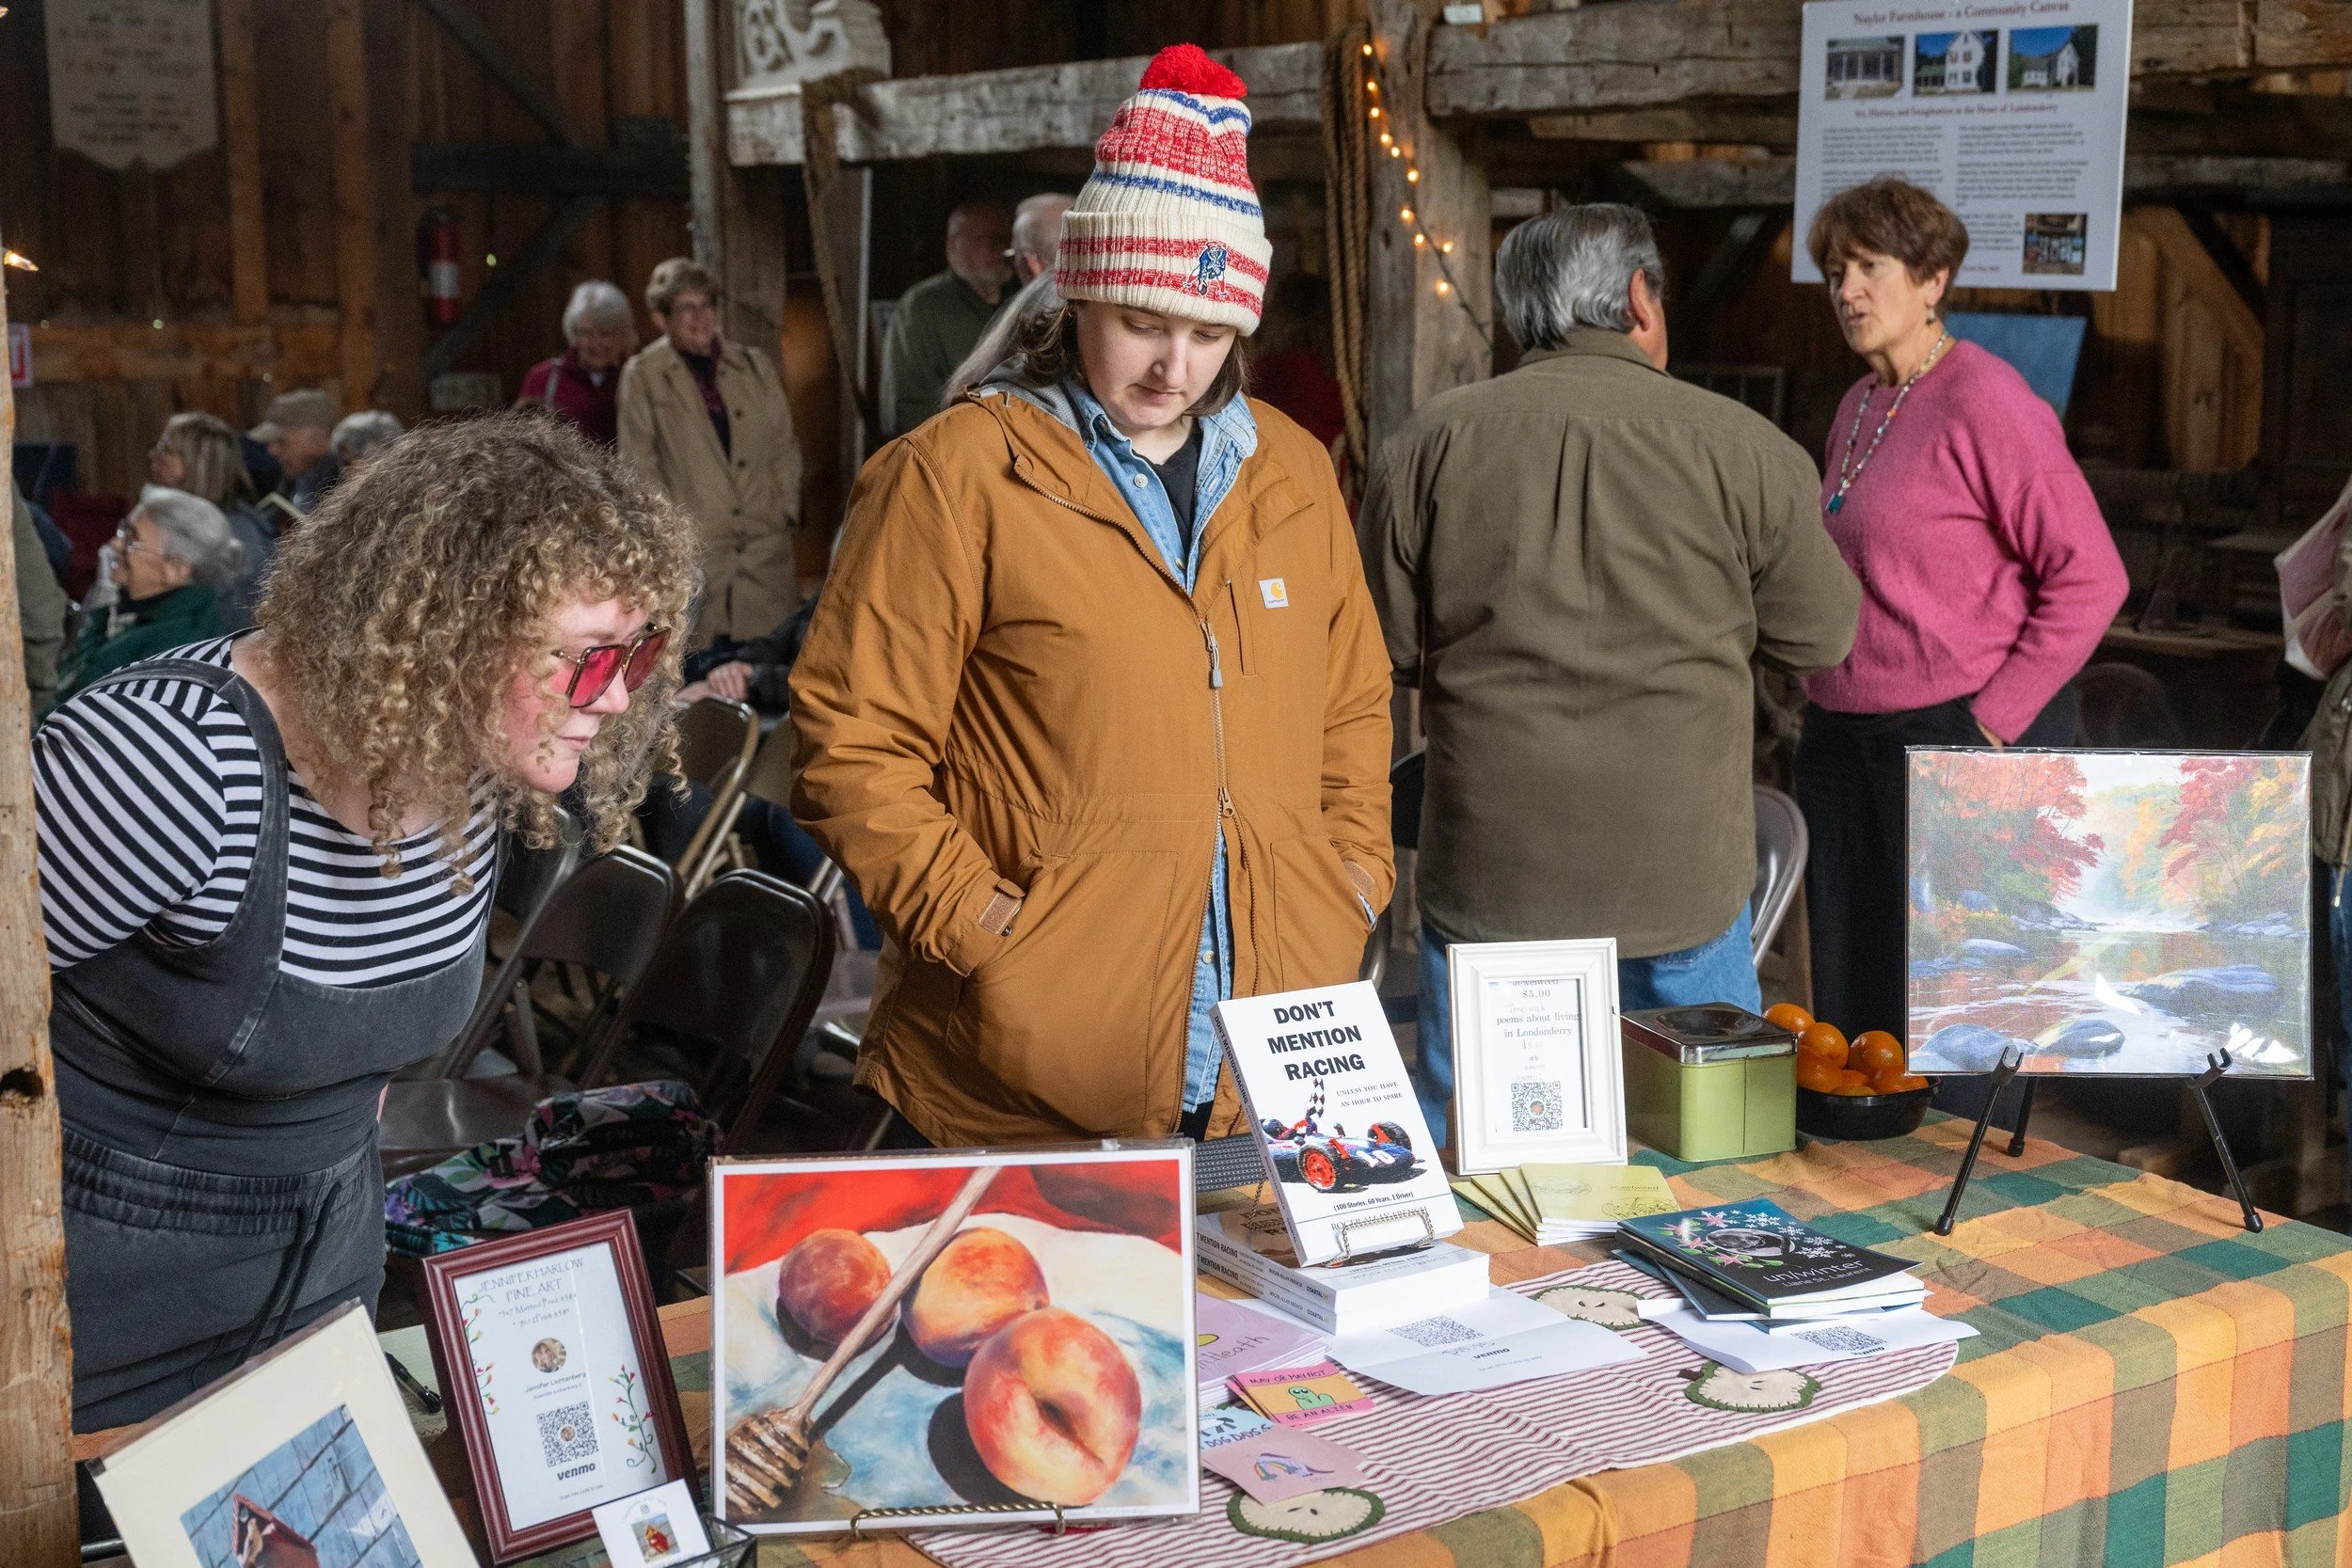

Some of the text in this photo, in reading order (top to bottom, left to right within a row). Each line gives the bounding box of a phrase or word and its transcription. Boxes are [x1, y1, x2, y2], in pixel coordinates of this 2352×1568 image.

[1963, 4, 2026, 20] Community
[2029, 1, 2069, 14] Canvas
[1522, 990, 1550, 999] $5.00
[1273, 1000, 1335, 1024] DON'T
[1497, 1011, 1580, 1026] poems about living
[1267, 1025, 1362, 1054] MENTION
[1505, 1026, 1572, 1037] in Londonderry
[1214, 1016, 1225, 1037] DON'T
[1223, 1038, 1237, 1074] MENTION
[1235, 1074, 1248, 1104] RACING
[1284, 1053, 1366, 1081] RACING
[1336, 1087, 1363, 1097] UNLESS
[1379, 1081, 1399, 1090] HAVE
[1351, 1097, 1372, 1106] HOUR
[1373, 1095, 1383, 1103] TO
[1383, 1092, 1404, 1101] SPARE
[1333, 1203, 1346, 1212] (100
[1347, 1200, 1368, 1210] Stories,
[1375, 1195, 1392, 1204] Years,
[1396, 1192, 1414, 1200] Driver)
[1200, 1232, 1220, 1250] MENTION
[1220, 1241, 1238, 1259] RACING
[478, 1258, 583, 1293] JENNIFER HARLOW
[1201, 1255, 1220, 1273] MENTION
[1220, 1263, 1239, 1280] RACING
[1763, 1260, 1864, 1282] un/winter
[1829, 1267, 1873, 1279] Laurent
[506, 1277, 563, 1302] FINE ART
[1306, 1285, 1323, 1298] COASTAL
[1307, 1308, 1324, 1322] COASTAL
[1473, 1348, 1510, 1359] venmo
[525, 1372, 586, 1393] Jennifer Lichtenberg
[1307, 1370, 1326, 1378] NOT
[1286, 1403, 1353, 1421] BE AN ALIEN
[1204, 1435, 1232, 1448] DOG
[1230, 1427, 1262, 1441] DAYS
[557, 1463, 596, 1481] venmo
